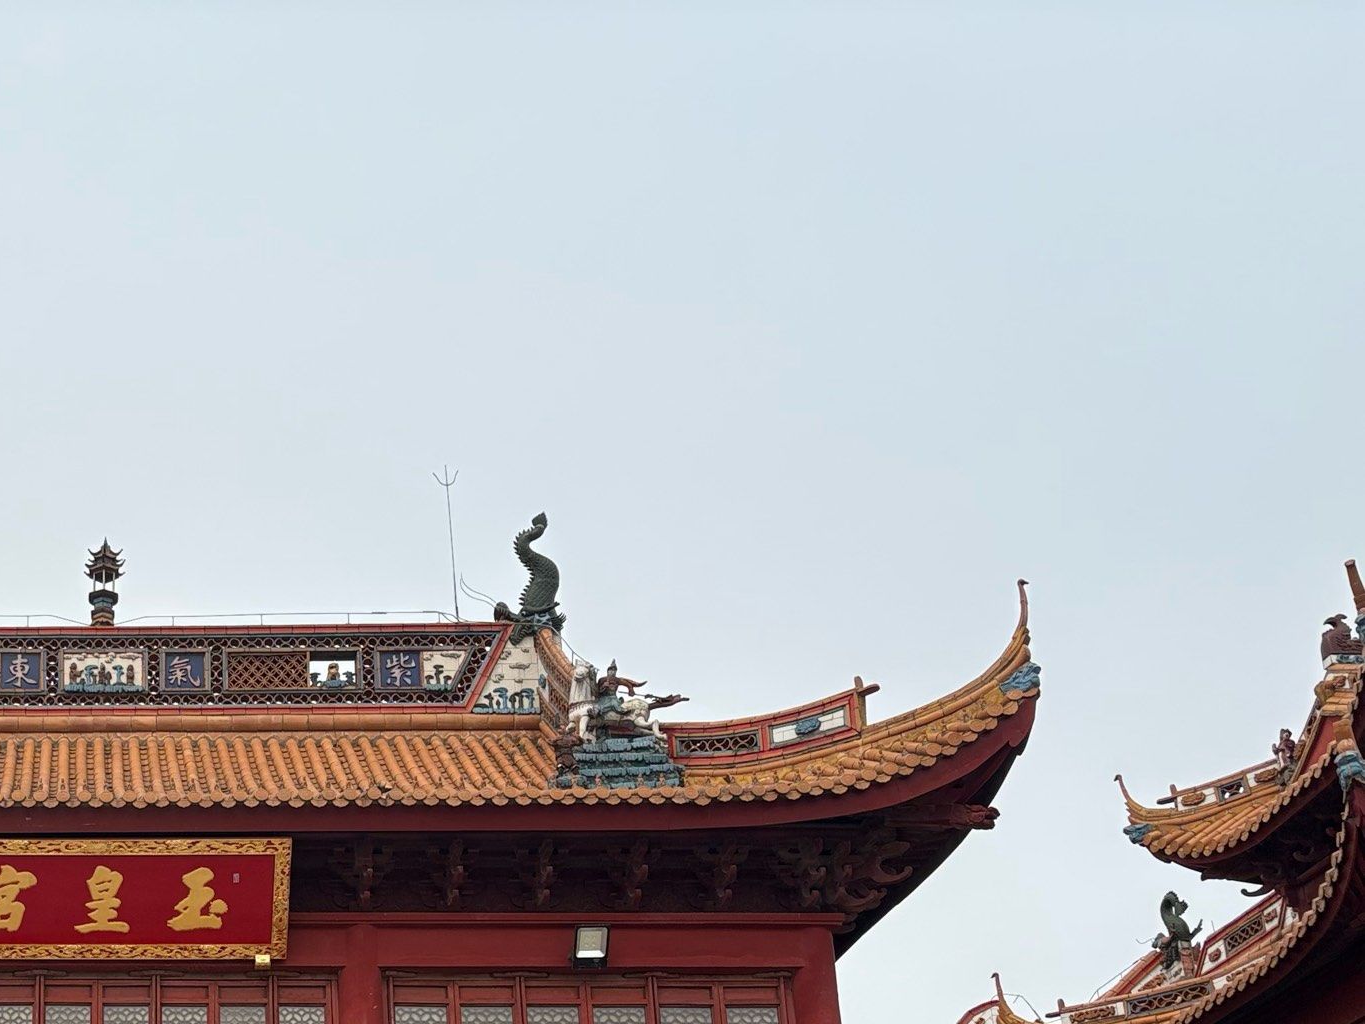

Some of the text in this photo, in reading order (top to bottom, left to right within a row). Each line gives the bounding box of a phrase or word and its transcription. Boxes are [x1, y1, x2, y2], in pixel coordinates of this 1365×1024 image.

[4, 654, 37, 688] 東
[167, 655, 202, 688] 氣
[384, 652, 416, 688] 紫
